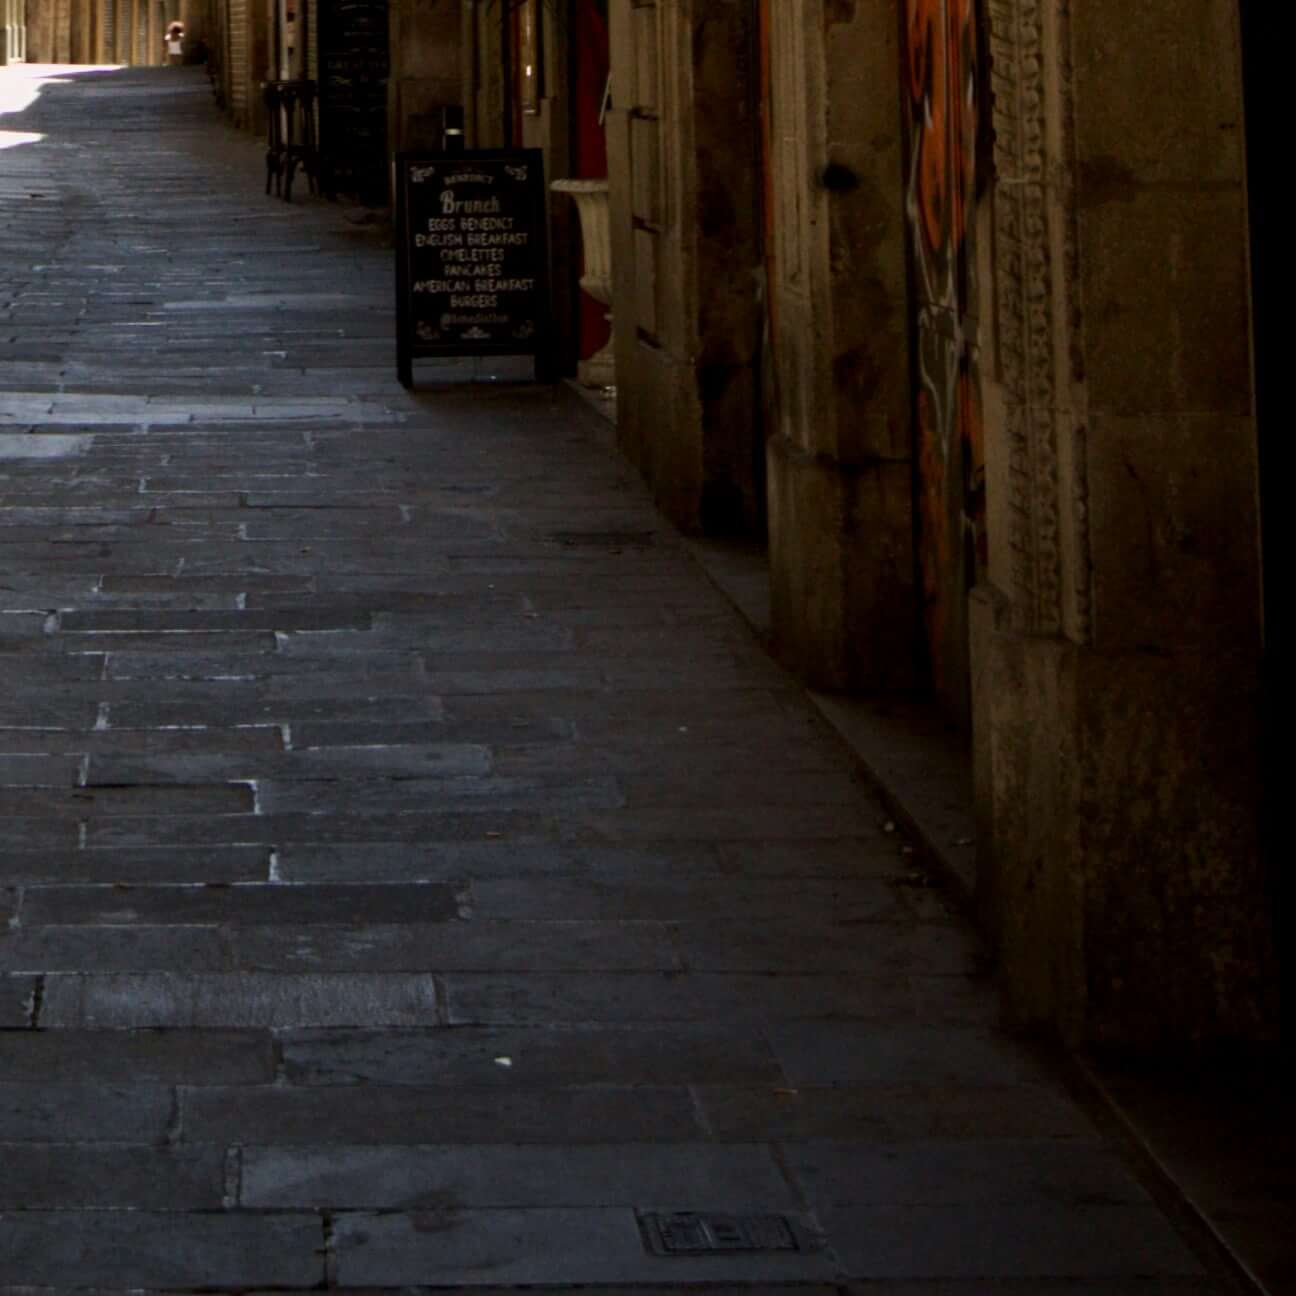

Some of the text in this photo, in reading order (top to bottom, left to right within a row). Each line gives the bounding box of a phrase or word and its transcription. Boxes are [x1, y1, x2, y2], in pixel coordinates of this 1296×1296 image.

[439, 189, 502, 214] Brunch
[427, 216, 514, 232] EGGS BENEDICT
[415, 232, 528, 248] ENGLISH BREAKFAST
[440, 248, 505, 262] OMELETTES
[443, 264, 503, 277] PANCAKES
[413, 278, 535, 294] AMERICAN BREAKFAST
[450, 294, 498, 308] BURGERS
